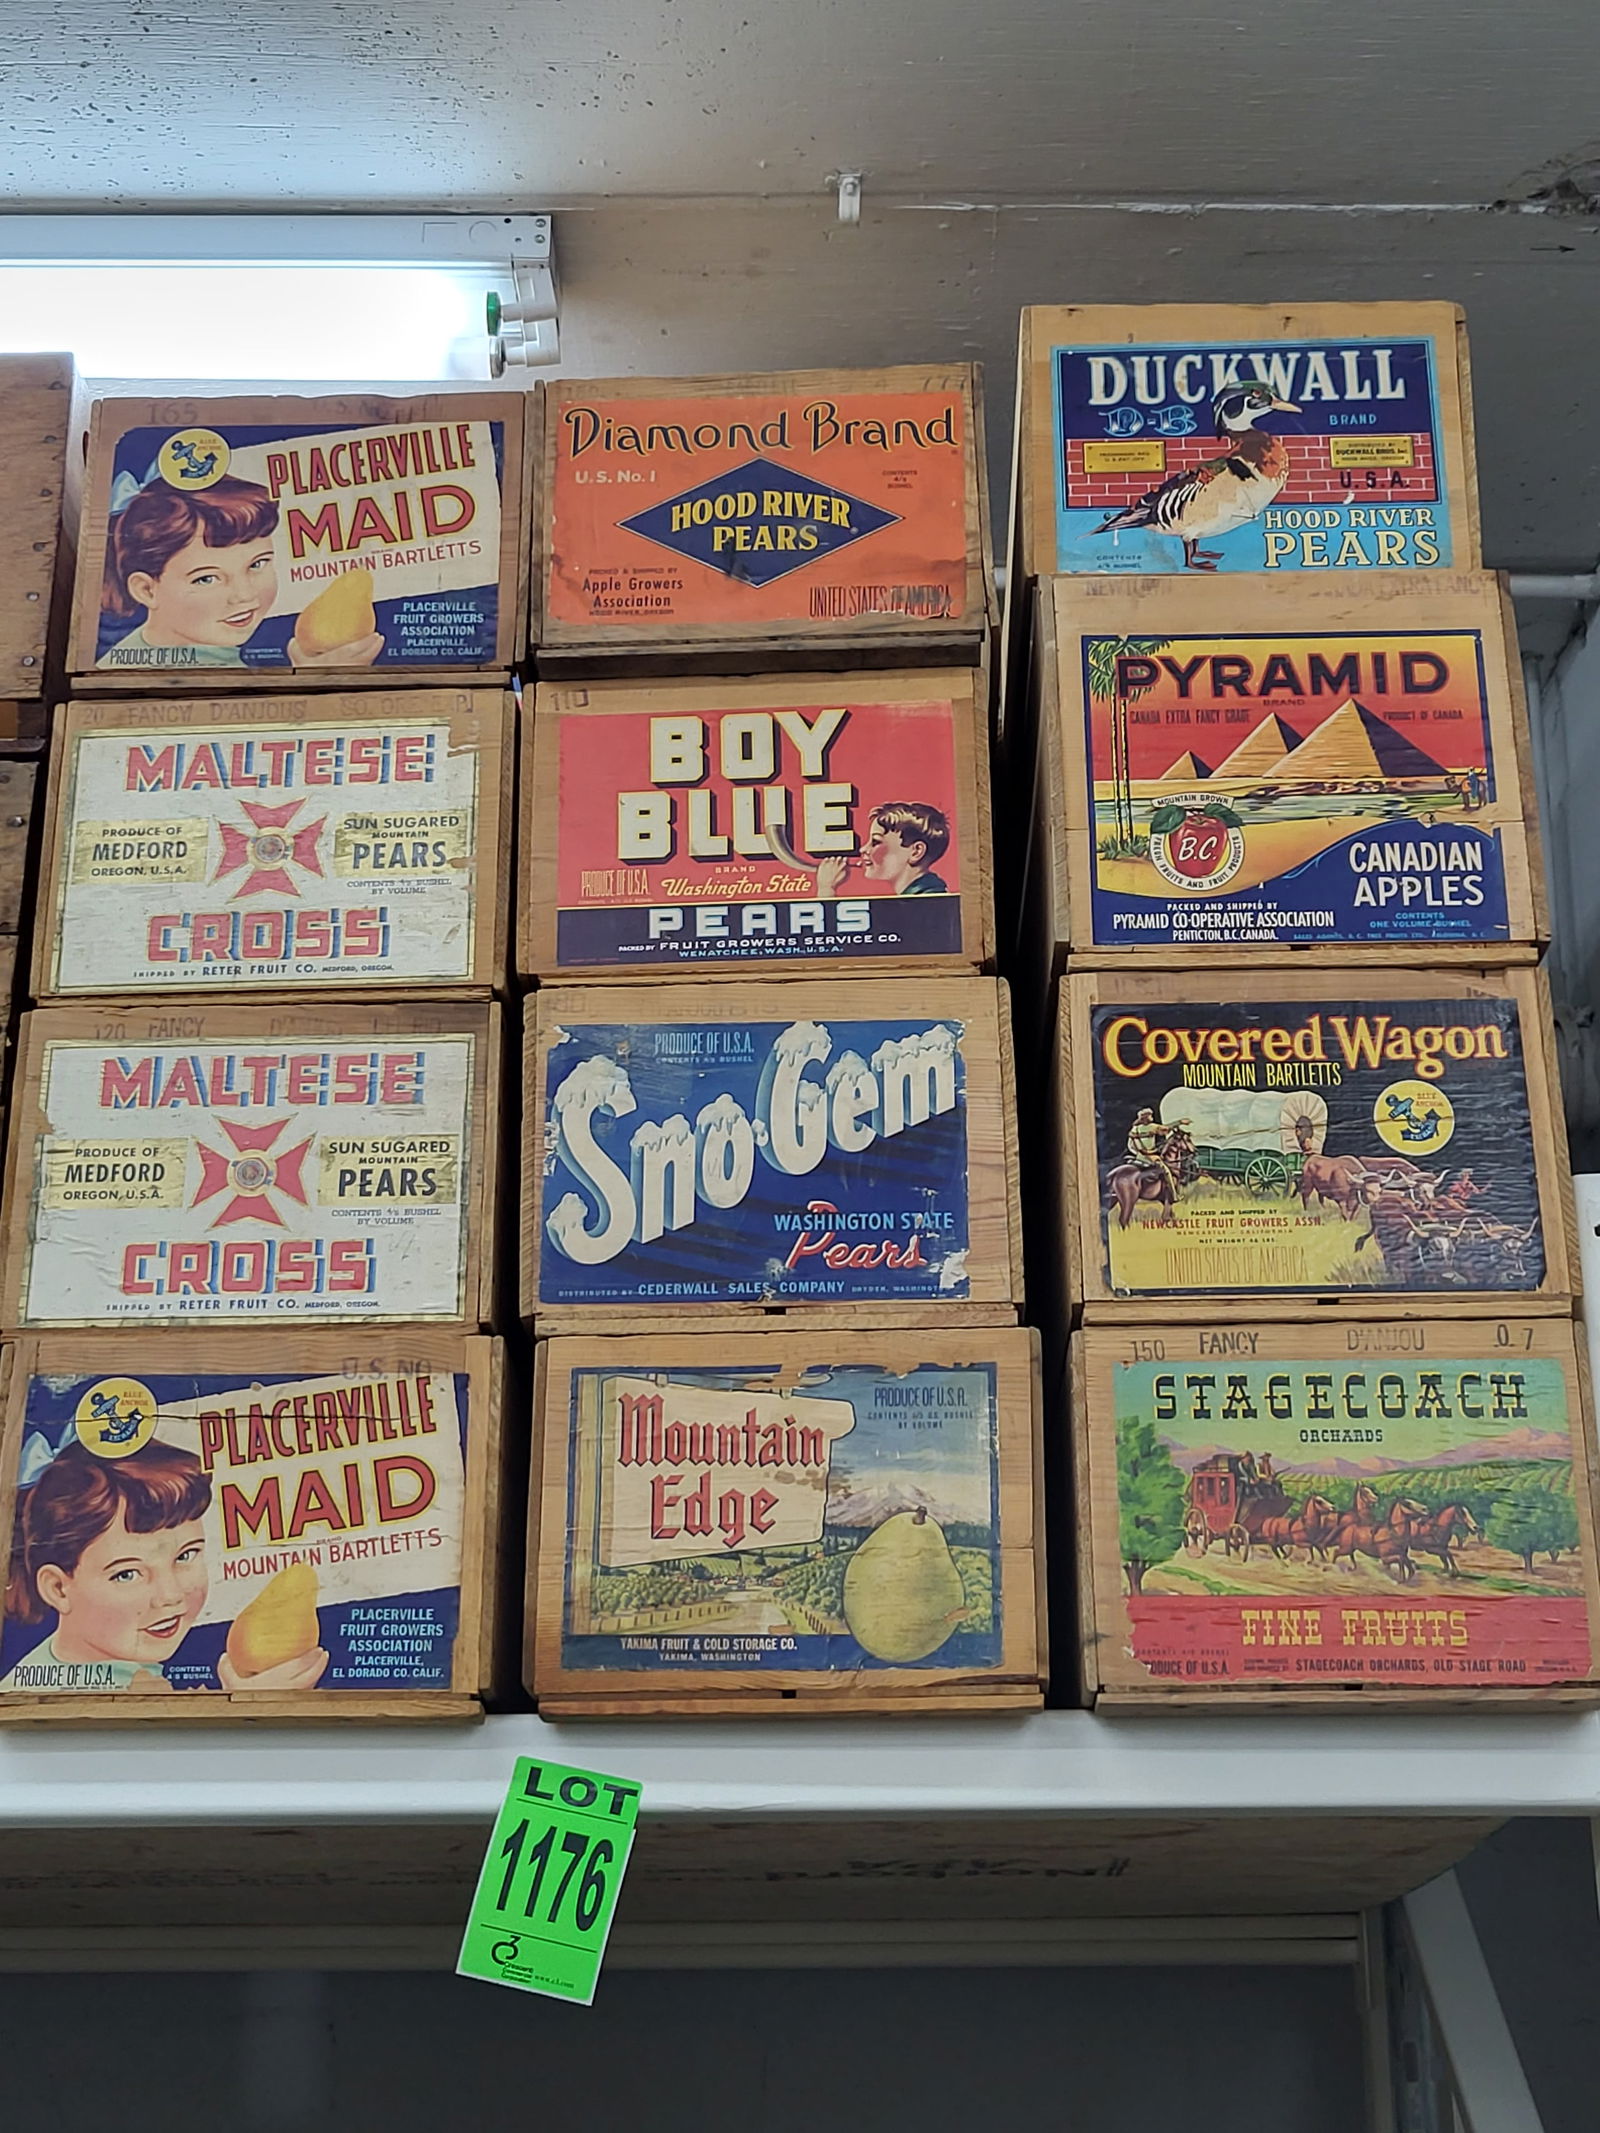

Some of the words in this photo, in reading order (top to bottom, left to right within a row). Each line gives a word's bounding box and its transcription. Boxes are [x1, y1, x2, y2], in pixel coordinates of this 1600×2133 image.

[1087, 349, 1405, 405] DUCKWALL
[565, 408, 794, 460] Diamond
[803, 400, 960, 455] Brand
[1329, 414, 1376, 426] BRAND
[267, 424, 475, 498] PLACERVILLE
[575, 471, 612, 483] U.S.
[617, 470, 645, 483] No.
[288, 485, 475, 557] MAID
[672, 492, 755, 532] HOOD
[762, 491, 851, 528] RIVER
[1265, 510, 1341, 528] HOOD
[1344, 509, 1434, 527] RIVER
[713, 525, 818, 552] PEARS
[1265, 531, 1440, 567] PEARS
[384, 540, 481, 568] BARTLETTS
[583, 577, 623, 593] Apple
[628, 577, 683, 591] Growers
[403, 602, 476, 612] PLACERVILLE
[593, 594, 670, 607] Association
[809, 587, 845, 617] UNITED
[394, 614, 425, 624] FRUIT
[430, 613, 484, 623] GROWERS
[401, 626, 474, 635] ASSOCIATION
[110, 648, 155, 665] PRODUCE
[157, 647, 169, 664] OF
[171, 646, 199, 663] U.S.A.
[1117, 651, 1449, 698] PYRAMID
[649, 708, 850, 787] BOY
[125, 734, 434, 792] MALTESE
[1157, 795, 1196, 806] MOUNTAIN
[1200, 795, 1228, 804] GROWN
[102, 828, 160, 837] PRODUCE
[166, 827, 182, 835] OF
[344, 818, 377, 829] SUN
[384, 816, 459, 828] SUGARED
[618, 783, 861, 864] BLUE
[92, 841, 187, 861] MEDFORD
[353, 841, 446, 869] PEARS
[1179, 836, 1217, 861] B.C.
[1349, 841, 1482, 872] CANADIAN
[151, 866, 187, 875] U.S.A.
[581, 870, 615, 897] PRODUCE
[616, 870, 627, 895] OF
[662, 875, 762, 897] Washington
[766, 874, 811, 893] State
[1354, 876, 1484, 907] APPLES
[1227, 902, 1263, 910] SHIPPED
[1267, 902, 1278, 910] BY
[649, 901, 871, 939] PEARS
[1113, 913, 1168, 929] PYRAMID
[1172, 912, 1255, 928] CO-OPERATIVE
[1257, 911, 1334, 926] ASSOCIATION
[149, 907, 389, 963] CROSS
[659, 941, 711, 951] FRUIT
[717, 936, 796, 949] GROWERS
[804, 934, 873, 946] SERVICE
[878, 933, 901, 943] CO.
[202, 965, 242, 976] RETER
[250, 964, 286, 974] FRUIT
[295, 964, 317, 974] CO.
[148, 1017, 205, 1037] FANCY
[655, 1034, 705, 1056] PRODUCE
[707, 1033, 721, 1053] OF
[724, 1032, 754, 1053] U.S.A.
[1103, 1014, 1325, 1078] Covered
[1328, 1015, 1509, 1078] Wagon
[99, 1051, 425, 1110] MALTESE
[1183, 1063, 1256, 1088] MOUNTAIN
[1266, 1062, 1342, 1087] BARTLETTS
[75, 1148, 137, 1157] PRODUCE
[143, 1147, 159, 1156] OF
[329, 1142, 364, 1154] SUN
[371, 1141, 450, 1153] SUGARED
[65, 1161, 165, 1183] MEDFORD
[338, 1168, 436, 1197] PEARS
[126, 1188, 164, 1199] U.S.A.
[774, 1213, 894, 1231] WASHINGTON
[900, 1212, 953, 1230] STATE
[1143, 1218, 1200, 1230] NEWCASTLE
[1206, 1218, 1234, 1228] FRUIT
[1240, 1217, 1288, 1227] GROWERS
[1295, 1216, 1325, 1226] ASSN.
[786, 1201, 928, 1270] Pears
[120, 1238, 375, 1296] CROSS
[638, 1283, 718, 1296] CEDERWALL
[728, 1282, 770, 1294] SALES
[780, 1281, 845, 1293] COMPANY
[179, 1299, 220, 1310] RETER
[229, 1298, 268, 1310] FRUIT
[276, 1298, 299, 1309] CO.
[1199, 1333, 1258, 1354] FANCY
[875, 1388, 920, 1407] PRODUCE
[922, 1388, 936, 1407] OF
[937, 1388, 967, 1407] U.S.A.
[1153, 1372, 1529, 1420] STAGECOACH
[200, 1377, 437, 1470] PLACERVILLE
[618, 1392, 826, 1469] Mountain
[1300, 1429, 1383, 1443] ORCHARDS
[221, 1456, 436, 1549] MAID
[650, 1471, 778, 1548] Edge
[330, 1528, 442, 1563] BARTLETTS
[351, 1609, 434, 1620] PLACERVILLE
[340, 1624, 377, 1636] FRUIT
[381, 1624, 443, 1636] GROWERS
[1242, 1611, 1322, 1646] FINE
[1342, 1611, 1469, 1646] FRUITS
[348, 1640, 432, 1651] ASSOCIATION
[621, 1637, 659, 1650] YAKIMA
[661, 1638, 690, 1651] FRUIT
[693, 1639, 700, 1651] &
[704, 1639, 729, 1651] COLD
[733, 1638, 777, 1650] STORAGE
[781, 1637, 798, 1650] CO.
[355, 1656, 423, 1666] PLACERVILLE,
[659, 1653, 696, 1662] YAKIMA,
[701, 1652, 761, 1661] WASHINGTON
[1295, 1659, 1364, 1672] STAGECOACH
[1370, 1659, 1428, 1673] ORCHARDS,
[1434, 1659, 1453, 1671] OLD
[1460, 1659, 1493, 1671] STAGE
[1499, 1659, 1526, 1671] ROAD
[14, 1665, 64, 1687] PRODUCE
[65, 1665, 80, 1686] OF
[82, 1665, 116, 1686] U.S.A.
[333, 1668, 344, 1677] EL
[348, 1668, 390, 1677] DORADO
[393, 1668, 410, 1677] CO.
[413, 1668, 444, 1677] CALIF.
[524, 1766, 638, 1815] LOT
[496, 1818, 614, 1931] 1176
